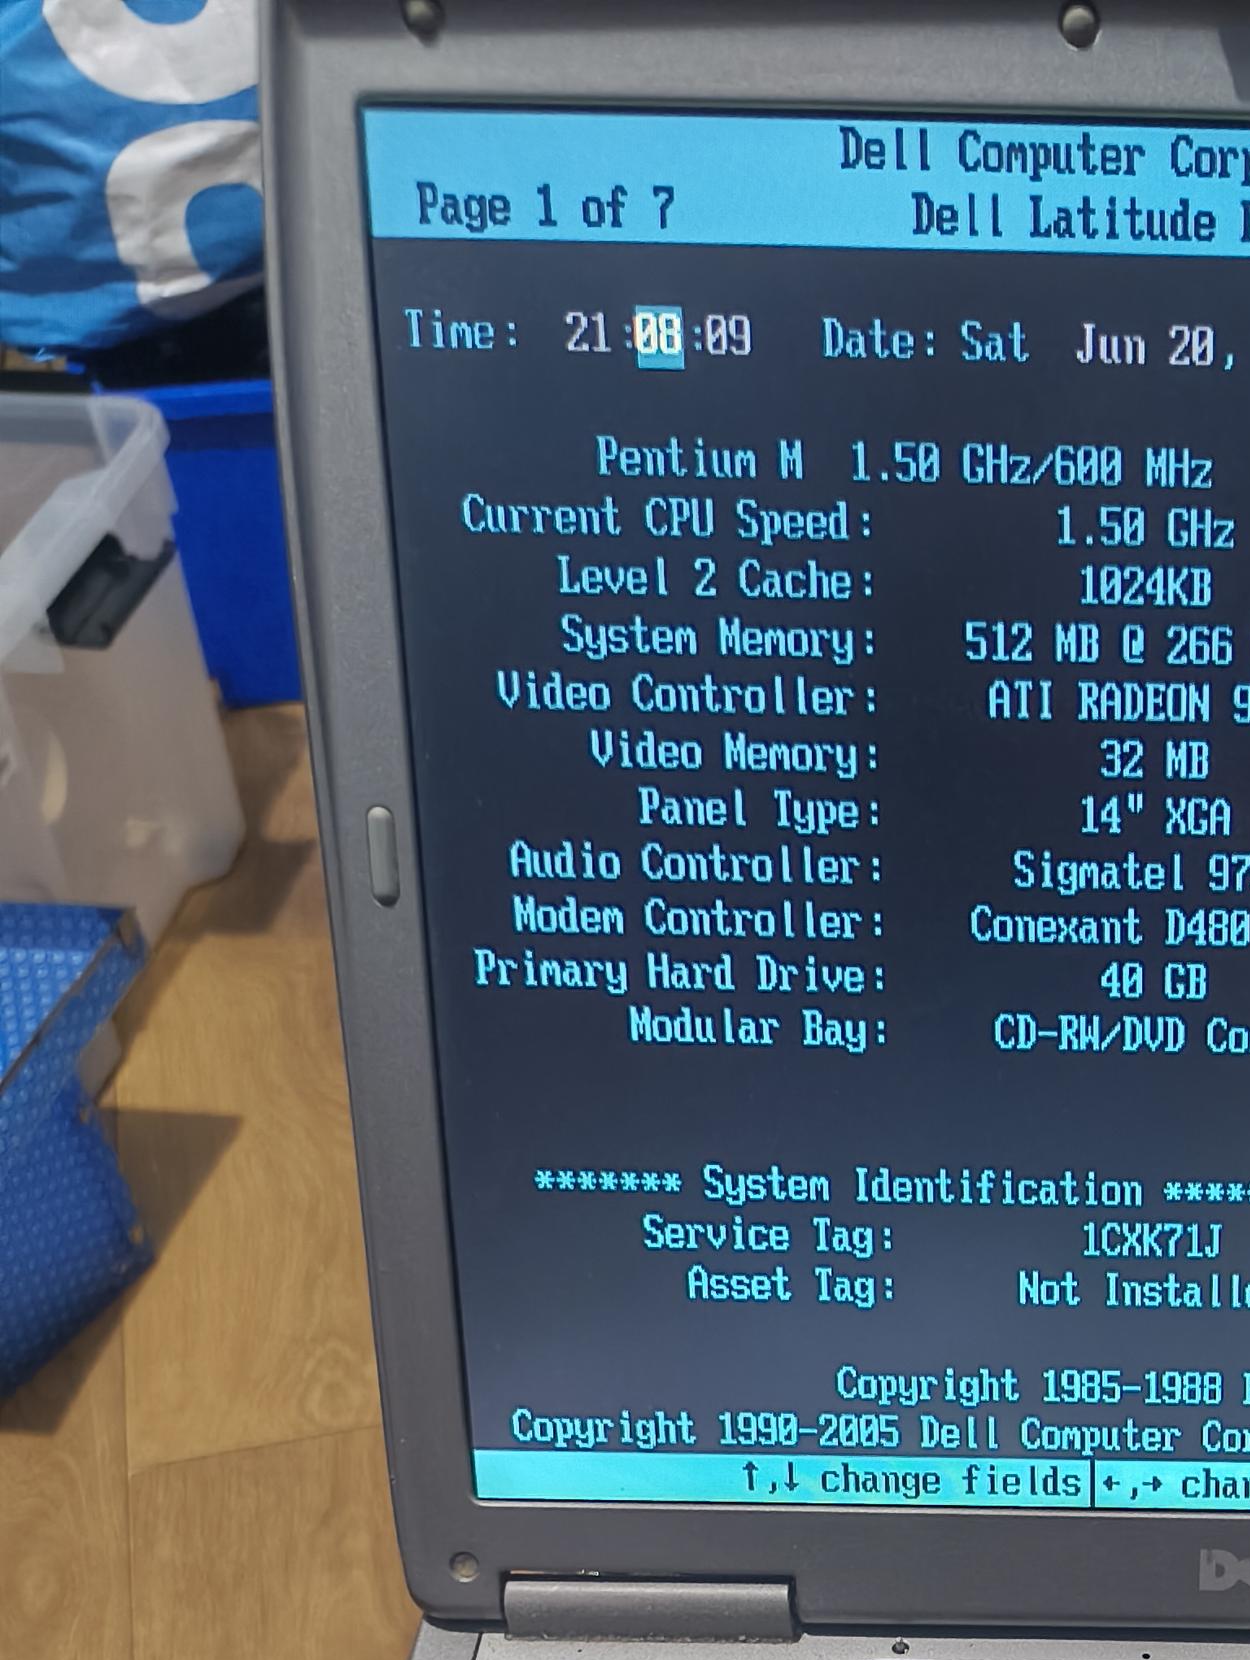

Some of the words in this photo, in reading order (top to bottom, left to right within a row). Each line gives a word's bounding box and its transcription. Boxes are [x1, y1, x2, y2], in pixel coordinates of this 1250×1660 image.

[840, 126, 930, 170] Dell
[959, 129, 1145, 182] Computer
[416, 181, 510, 232] Page
[537, 184, 557, 226] 1
[582, 185, 627, 227] of
[653, 186, 674, 229] 7
[912, 192, 1002, 236] Dell
[1030, 195, 1216, 241] Latitude
[405, 309, 516, 348] Time:
[823, 318, 933, 358] Date:
[961, 320, 1029, 362] Sat
[1077, 323, 1145, 364] Jun
[1169, 325, 1233, 370] 20,
[597, 436, 756, 477] Pentium
[781, 440, 802, 478] M
[853, 441, 939, 482] 1.50
[963, 443, 1121, 485] GHz/600
[1147, 448, 1212, 488] MHz
[462, 494, 621, 535] Current
[646, 498, 713, 536] CPU
[737, 499, 870, 545] Speed:
[1058, 506, 1144, 546] 1.50
[1168, 508, 1234, 547] GHz
[561, 614, 696, 659] System
[719, 618, 873, 664] Memory:
[966, 622, 1032, 661] 512
[1056, 624, 1098, 662] MB
[1123, 625, 1144, 663] @
[1167, 626, 1232, 665] 266
[514, 895, 623, 933] Modem
[645, 898, 881, 938] Controller:
[971, 905, 1142, 944] Conexant
[1166, 909, 1250, 946] D480
[630, 1006, 779, 1044] Modular
[802, 1010, 884, 1053] Bay:
[995, 1014, 1184, 1051] CD-RW/DVD
[643, 1214, 789, 1250] Service
[813, 1218, 891, 1258] Tag:
[1084, 1222, 1222, 1257] 1CXK71J
[688, 1266, 791, 1300] Asset
[815, 1268, 893, 1307] Tag:
[1020, 1271, 1080, 1305] Not
[837, 1366, 1019, 1406] Copyright
[1044, 1370, 1223, 1404] 1985-1988
[822, 1463, 940, 1499] change
[963, 1464, 1080, 1496] fields
